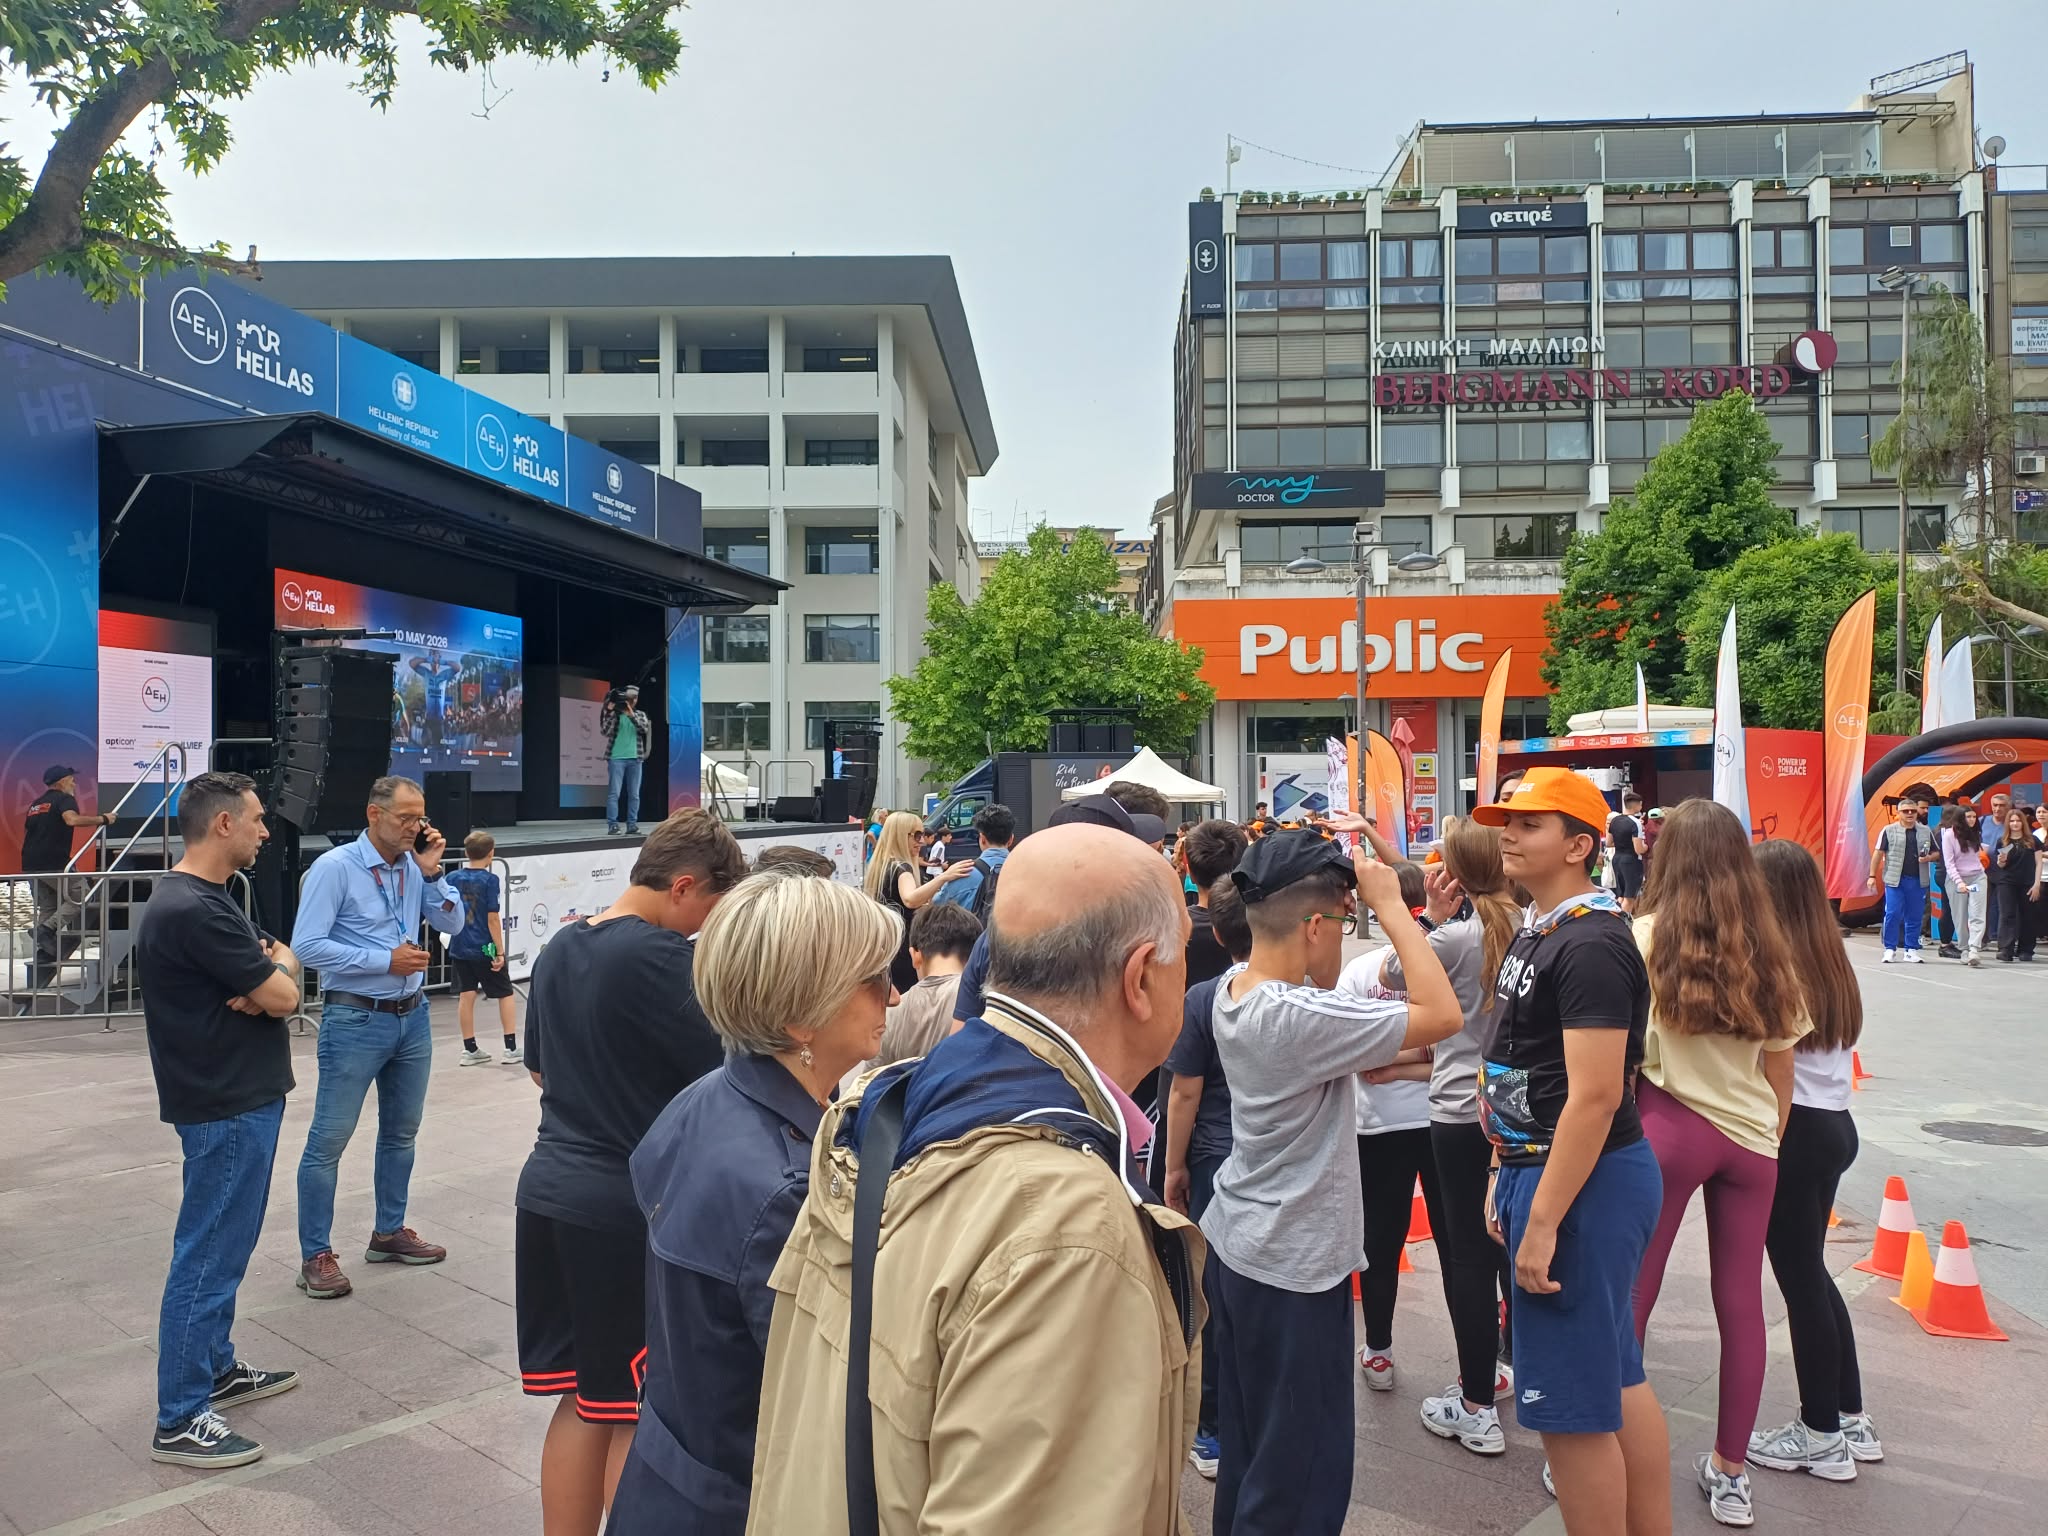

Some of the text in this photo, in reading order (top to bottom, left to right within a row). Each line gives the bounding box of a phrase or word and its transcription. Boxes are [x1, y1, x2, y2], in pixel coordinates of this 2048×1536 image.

[1490, 205, 1553, 227] ρετιρέ
[1371, 336, 1606, 359] ΚΛΙΝΙΚΗ ΜΑΛΛΙΩΝ
[236, 347, 315, 397] HELLAS
[1373, 365, 1791, 407] BERGMANN KORD
[368, 405, 439, 439] HELLENIC REPUBLIC
[378, 422, 431, 449] Ministry of Sports
[513, 454, 560, 488] HELLAS
[1237, 493, 1275, 503] DOCTOR
[305, 600, 336, 615] HELLAS
[394, 628, 449, 649] 10 MAY 2026
[1239, 618, 1485, 675] Public
[145, 686, 167, 703] ΔΕΗ
[105, 738, 135, 746] apticon
[1056, 763, 1077, 777] Ride
[1777, 757, 1807, 767] POWER UP
[1778, 766, 1807, 776] THE RACE
[1056, 776, 1068, 788] the
[1524, 1388, 1541, 1399] NIKE
